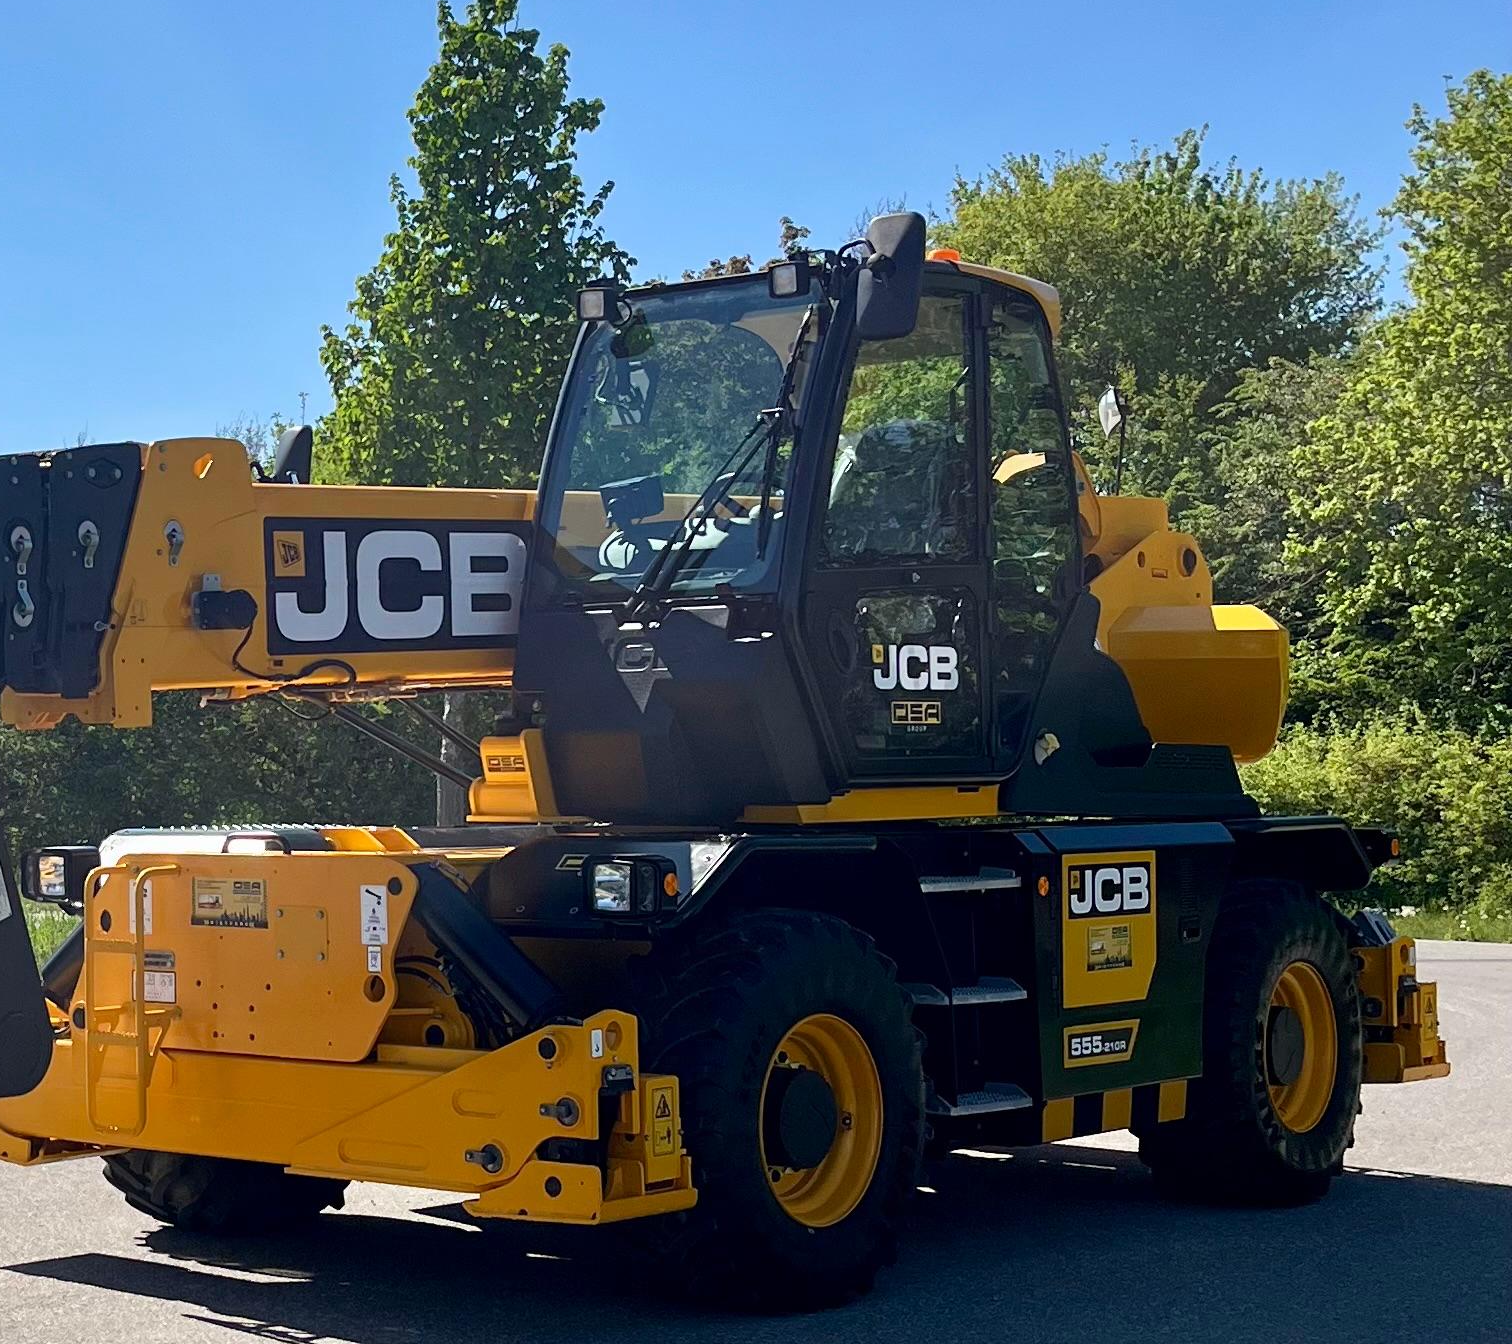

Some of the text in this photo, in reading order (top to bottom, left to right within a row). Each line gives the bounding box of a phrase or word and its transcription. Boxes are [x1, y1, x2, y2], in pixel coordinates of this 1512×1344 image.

[276, 530, 527, 641] JCB
[874, 644, 959, 691] JCB
[1070, 867, 1149, 914] JCB
[1071, 1035, 1127, 1056] 555-210R
